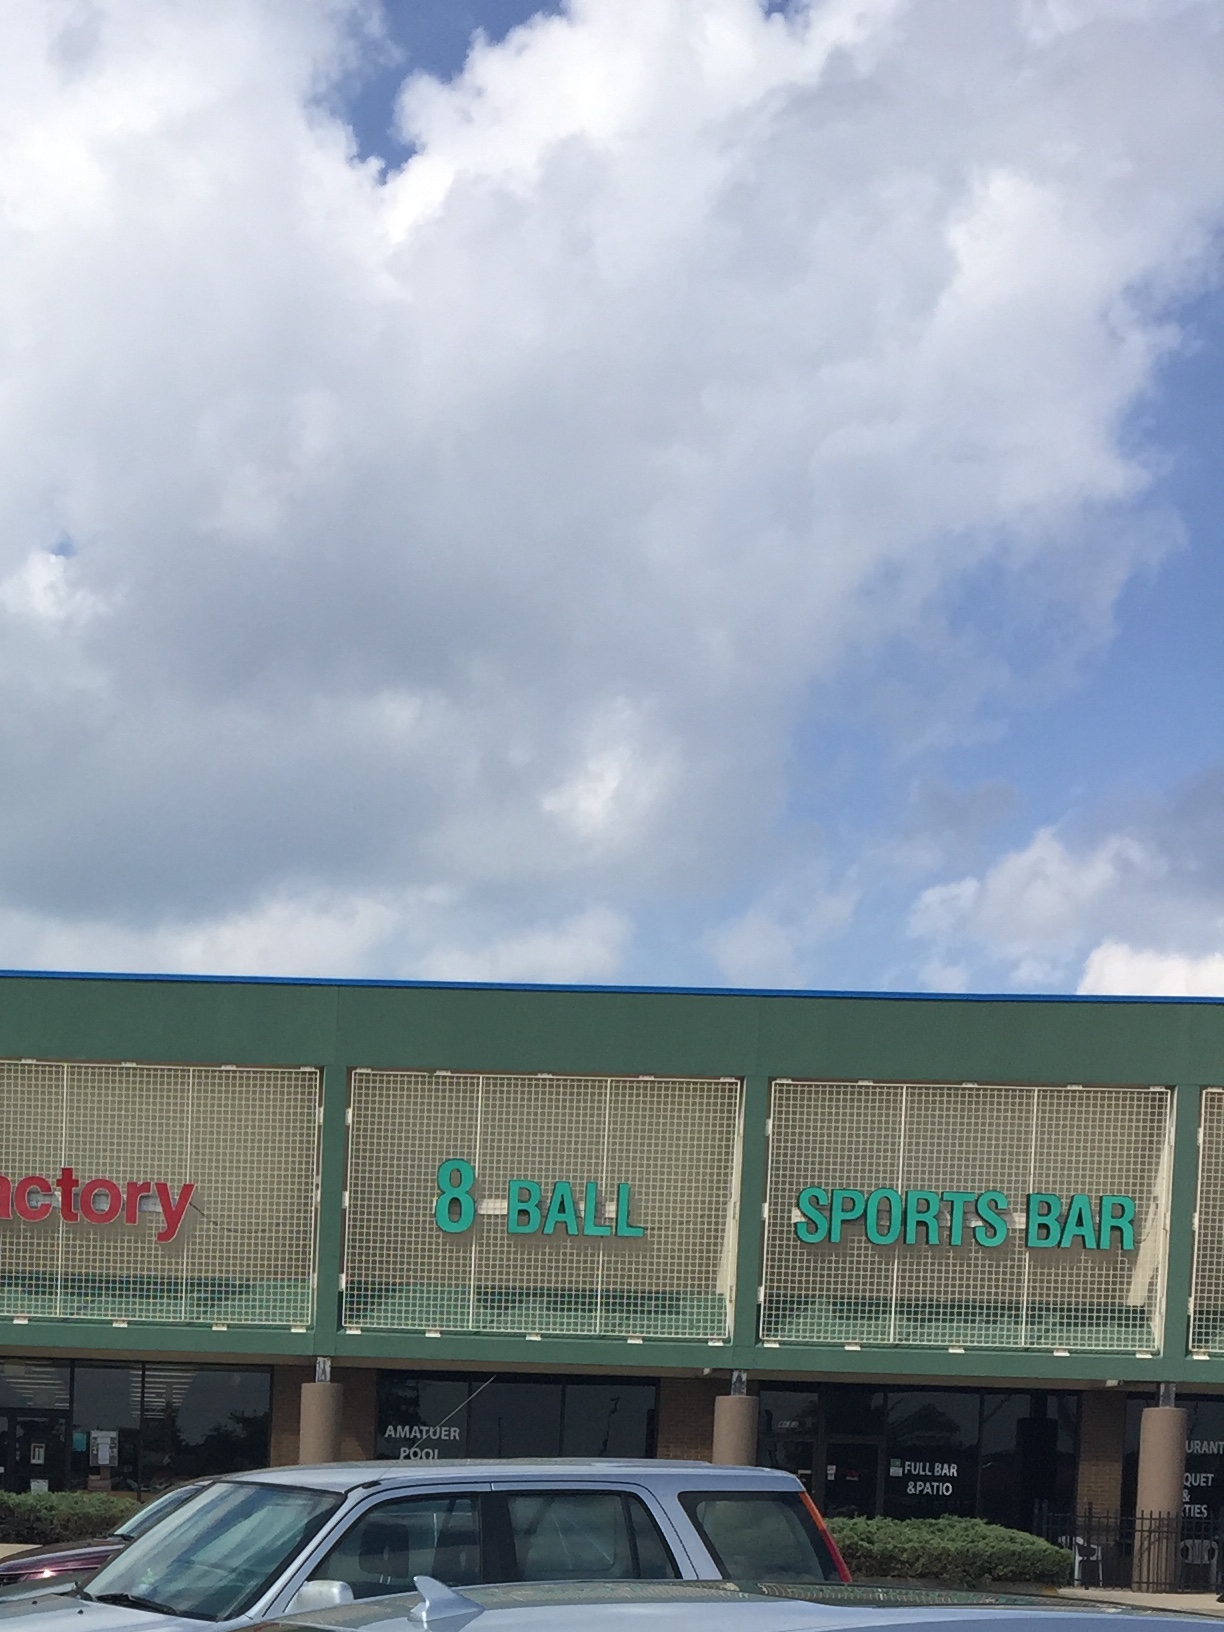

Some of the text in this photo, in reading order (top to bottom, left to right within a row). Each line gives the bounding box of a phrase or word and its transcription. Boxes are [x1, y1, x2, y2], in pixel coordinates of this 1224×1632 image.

[435, 1158, 645, 1237] 8 BALL
[795, 1186, 1136, 1250] SPORTS BAR
[384, 1425, 460, 1440] AMATUER
[1185, 1440, 1224, 1454] URANT
[904, 1461, 958, 1477] FULL BAR
[1183, 1472, 1214, 1487] QUET
[907, 1482, 953, 1496] &PATIO
[1182, 1504, 1208, 1518] TIES
